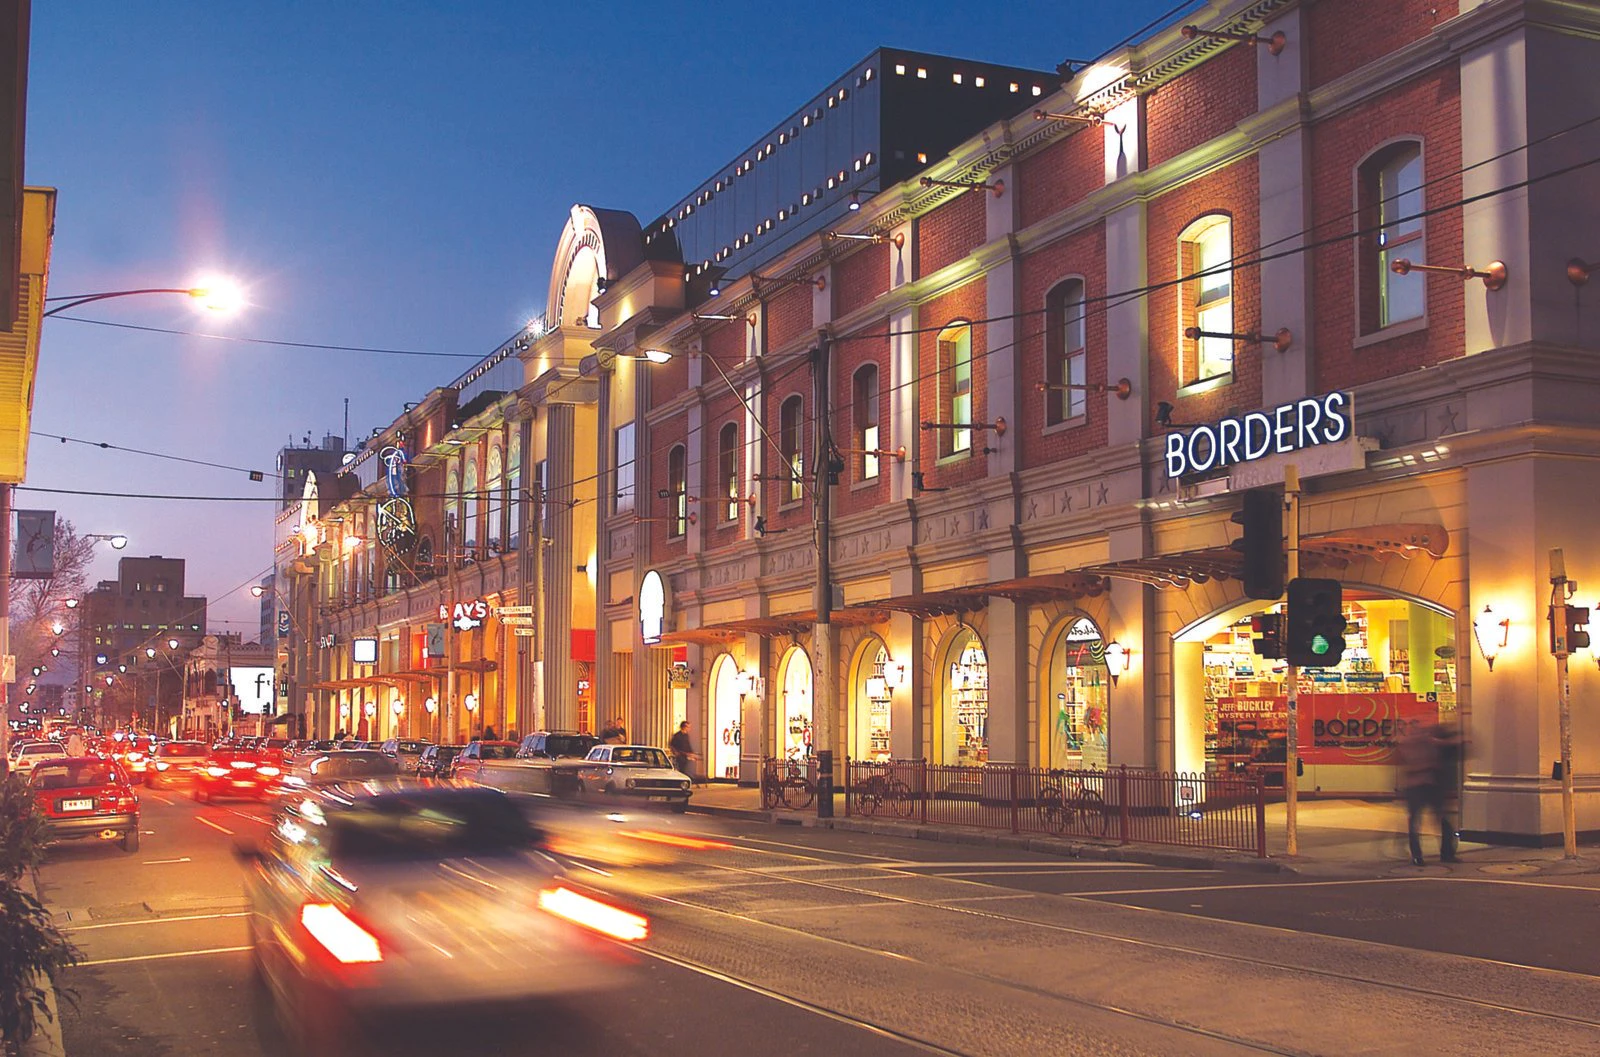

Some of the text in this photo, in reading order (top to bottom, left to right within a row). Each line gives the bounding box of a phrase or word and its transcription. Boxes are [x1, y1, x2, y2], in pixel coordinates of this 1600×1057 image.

[1166, 392, 1345, 478] BORDERS
[1220, 700, 1274, 712] JEFF BUCKLEY
